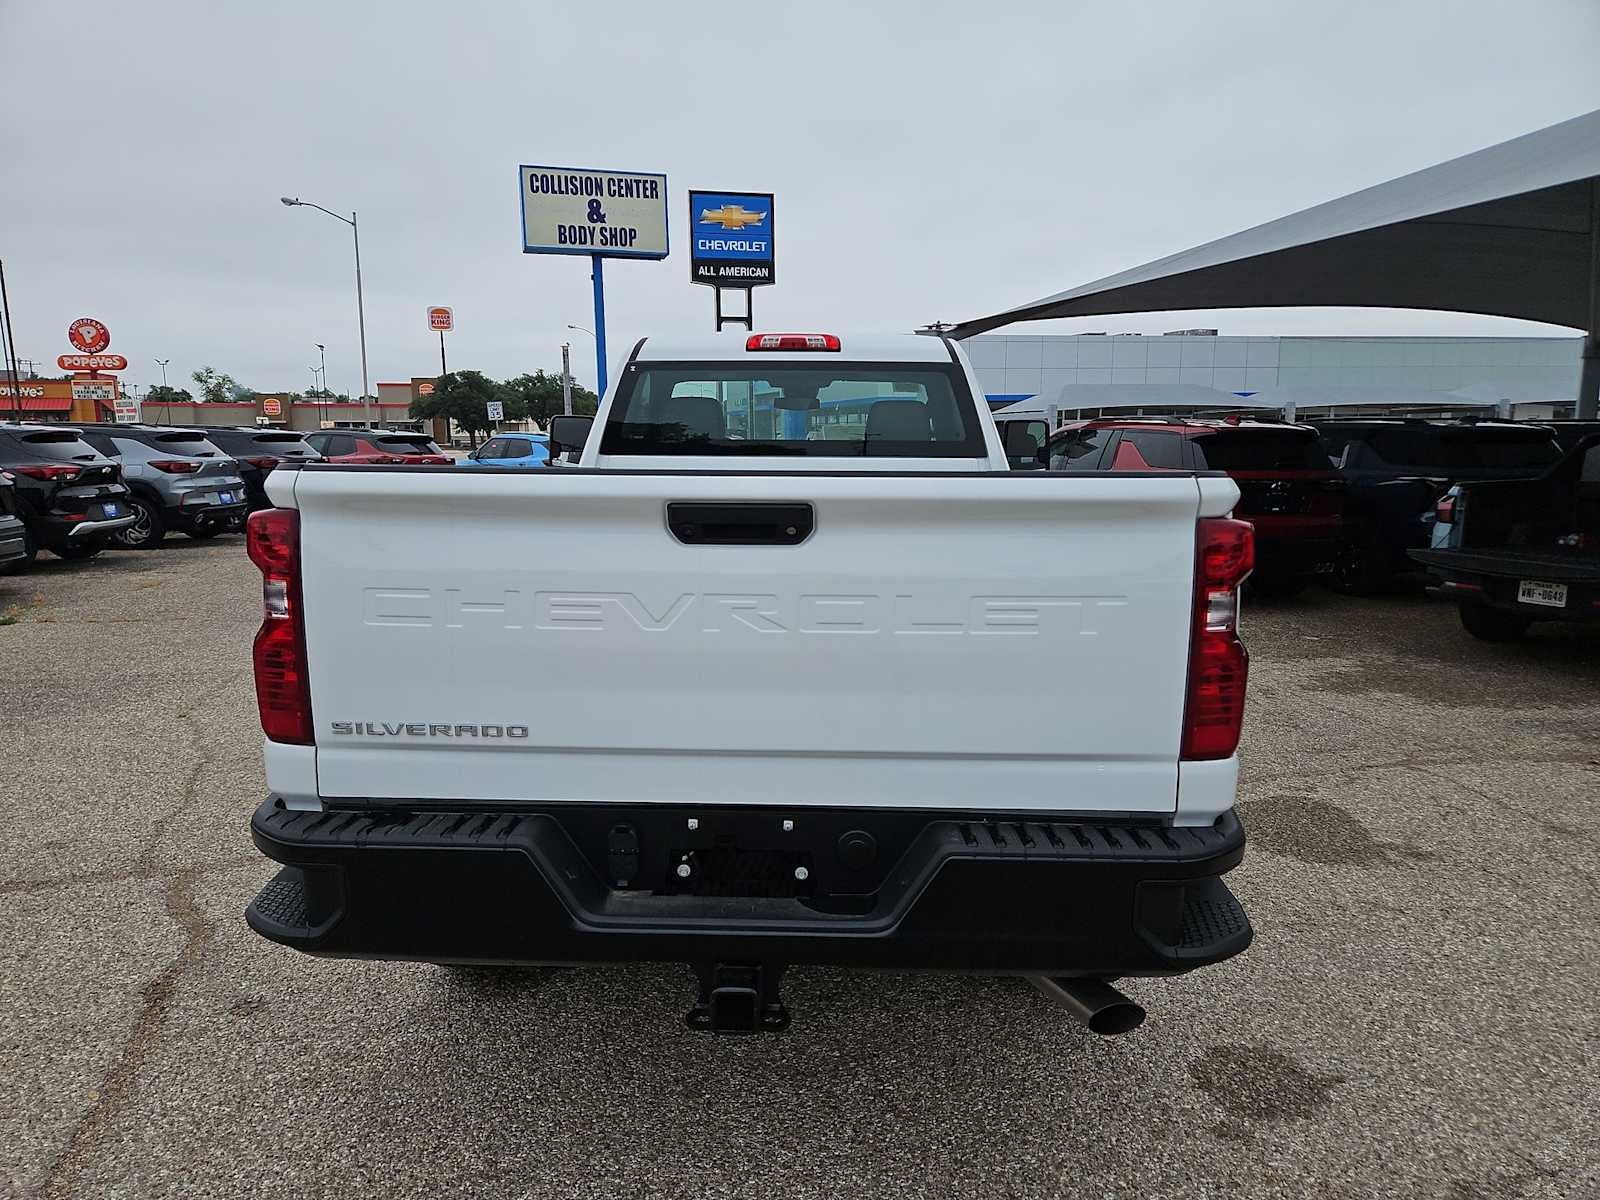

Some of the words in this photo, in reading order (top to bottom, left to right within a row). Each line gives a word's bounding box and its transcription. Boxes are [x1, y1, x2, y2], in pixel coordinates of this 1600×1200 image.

[529, 173, 604, 197] COLLISION
[607, 177, 660, 200] CENTER
[586, 198, 607, 224] &
[557, 224, 596, 246] BODY
[599, 226, 638, 248] SHOP
[698, 239, 767, 252] CHEVROLET
[698, 265, 717, 276] ALL
[719, 266, 769, 278] AMERICAN
[490, 411, 502, 419] 35
[363, 587, 1128, 635] CHEVROLET
[331, 721, 529, 739] SILVERADO
